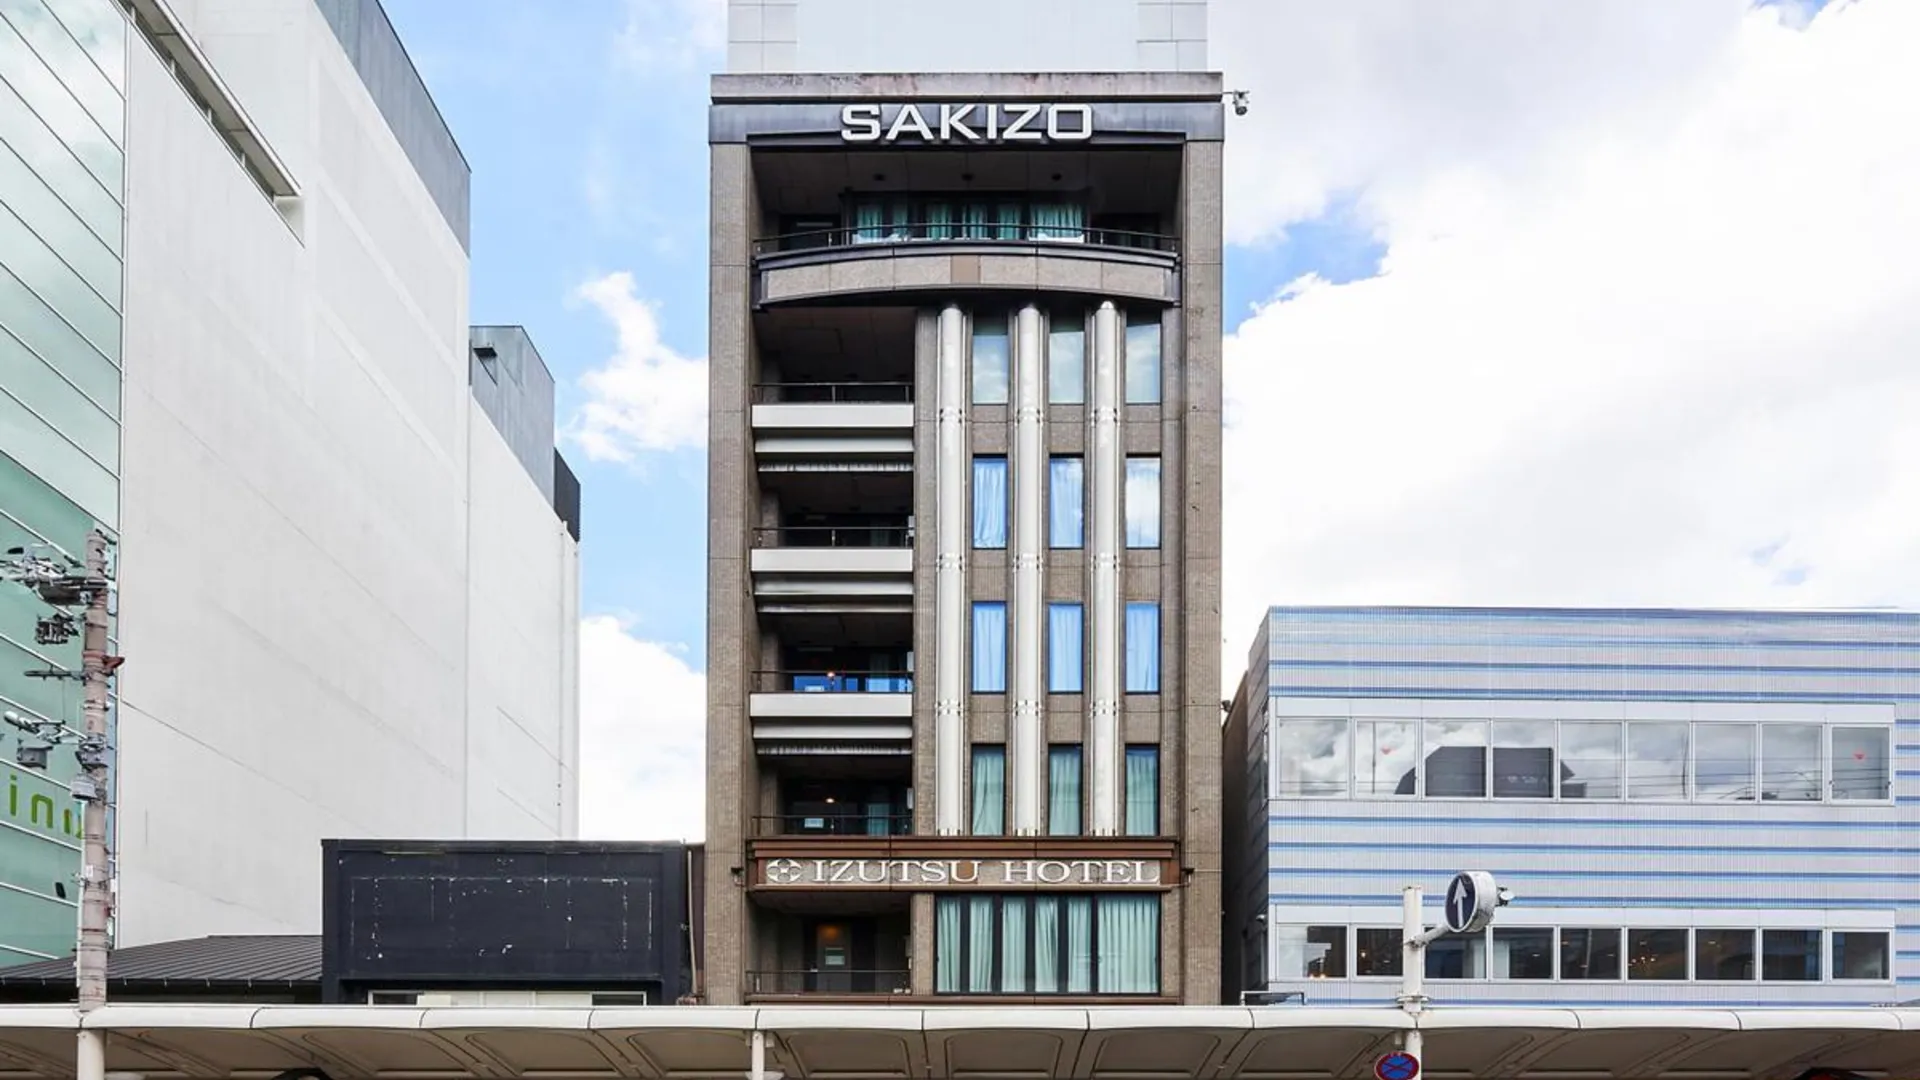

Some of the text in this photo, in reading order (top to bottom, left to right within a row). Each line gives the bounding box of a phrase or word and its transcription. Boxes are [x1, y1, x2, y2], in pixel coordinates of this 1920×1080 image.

[841, 104, 1092, 141] SAKIZO
[812, 859, 1160, 884] IZUTSU HOTEL
